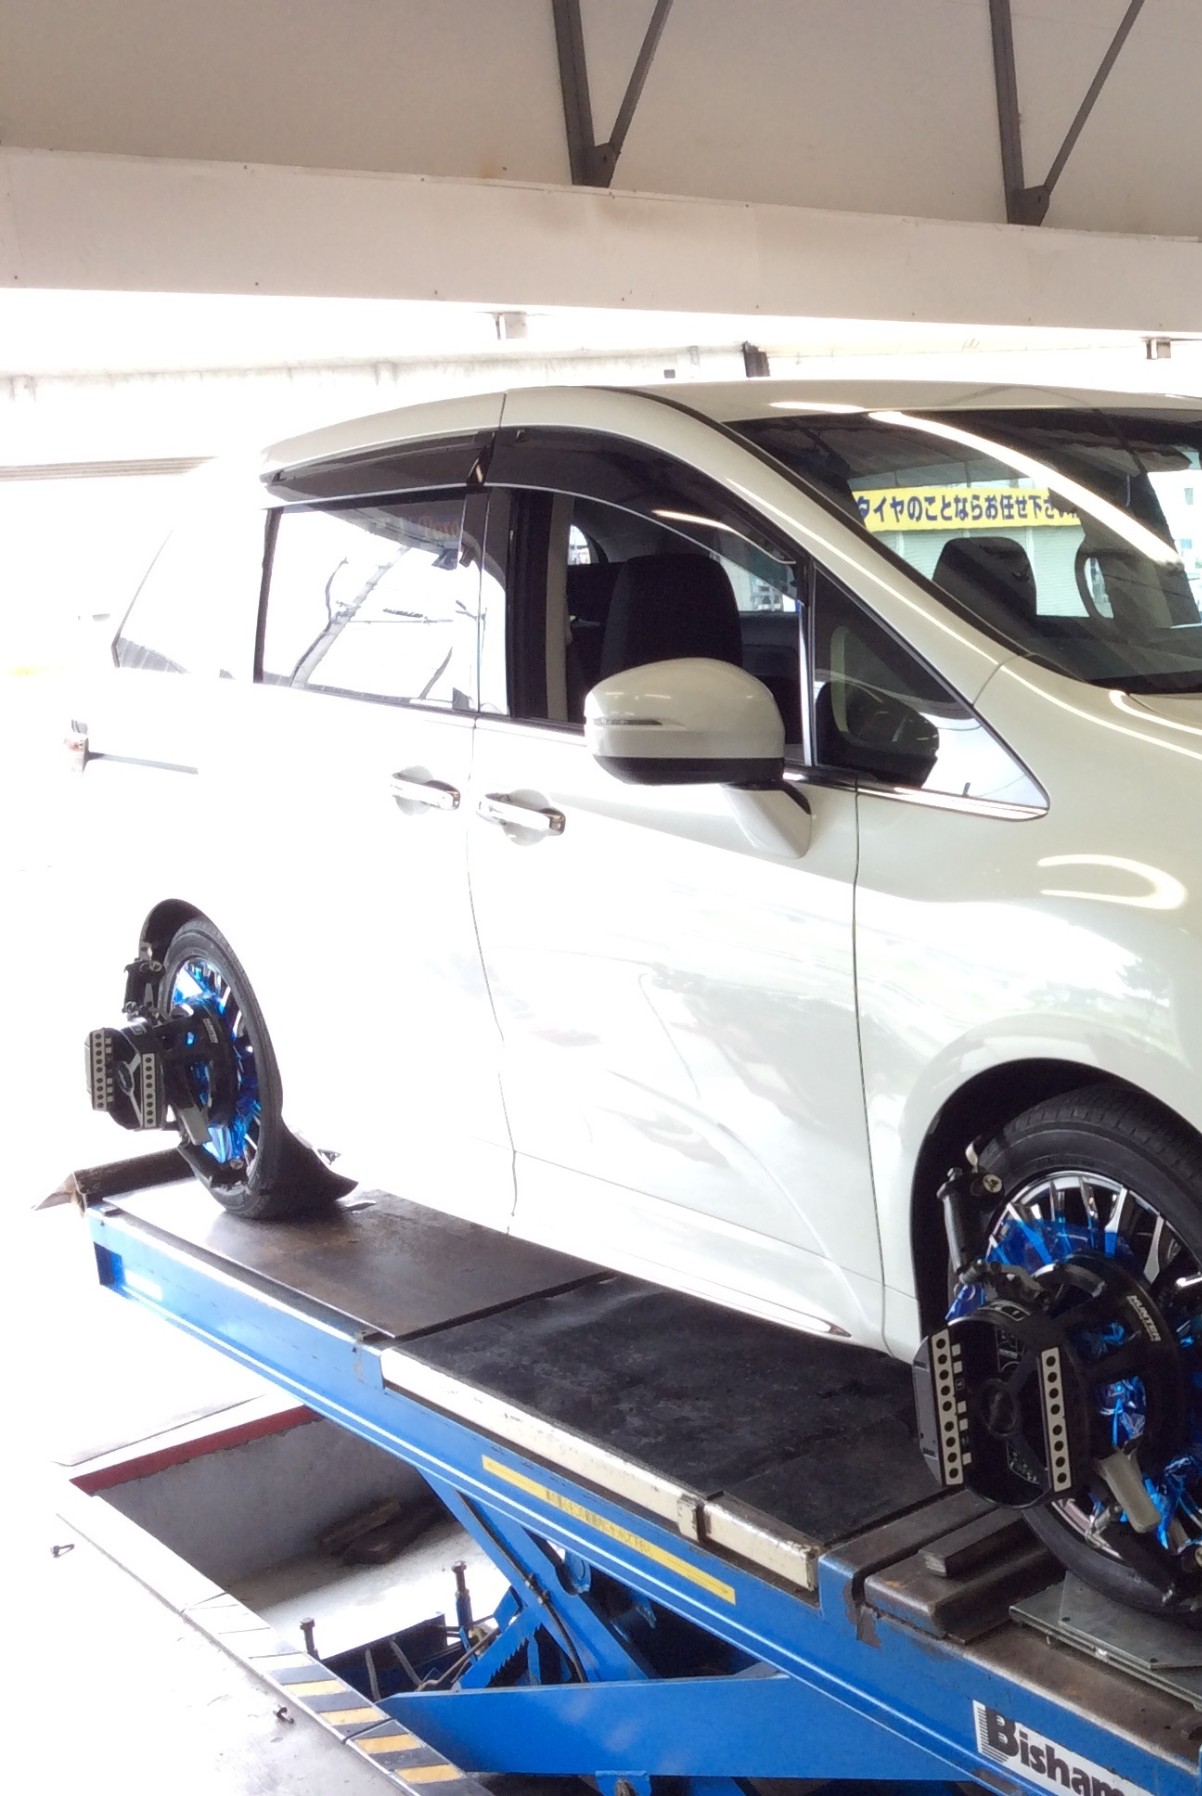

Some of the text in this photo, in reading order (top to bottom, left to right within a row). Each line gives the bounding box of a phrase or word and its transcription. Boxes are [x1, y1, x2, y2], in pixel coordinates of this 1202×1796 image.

[857, 494, 1078, 522] タイヤのことならお任せ下さ
